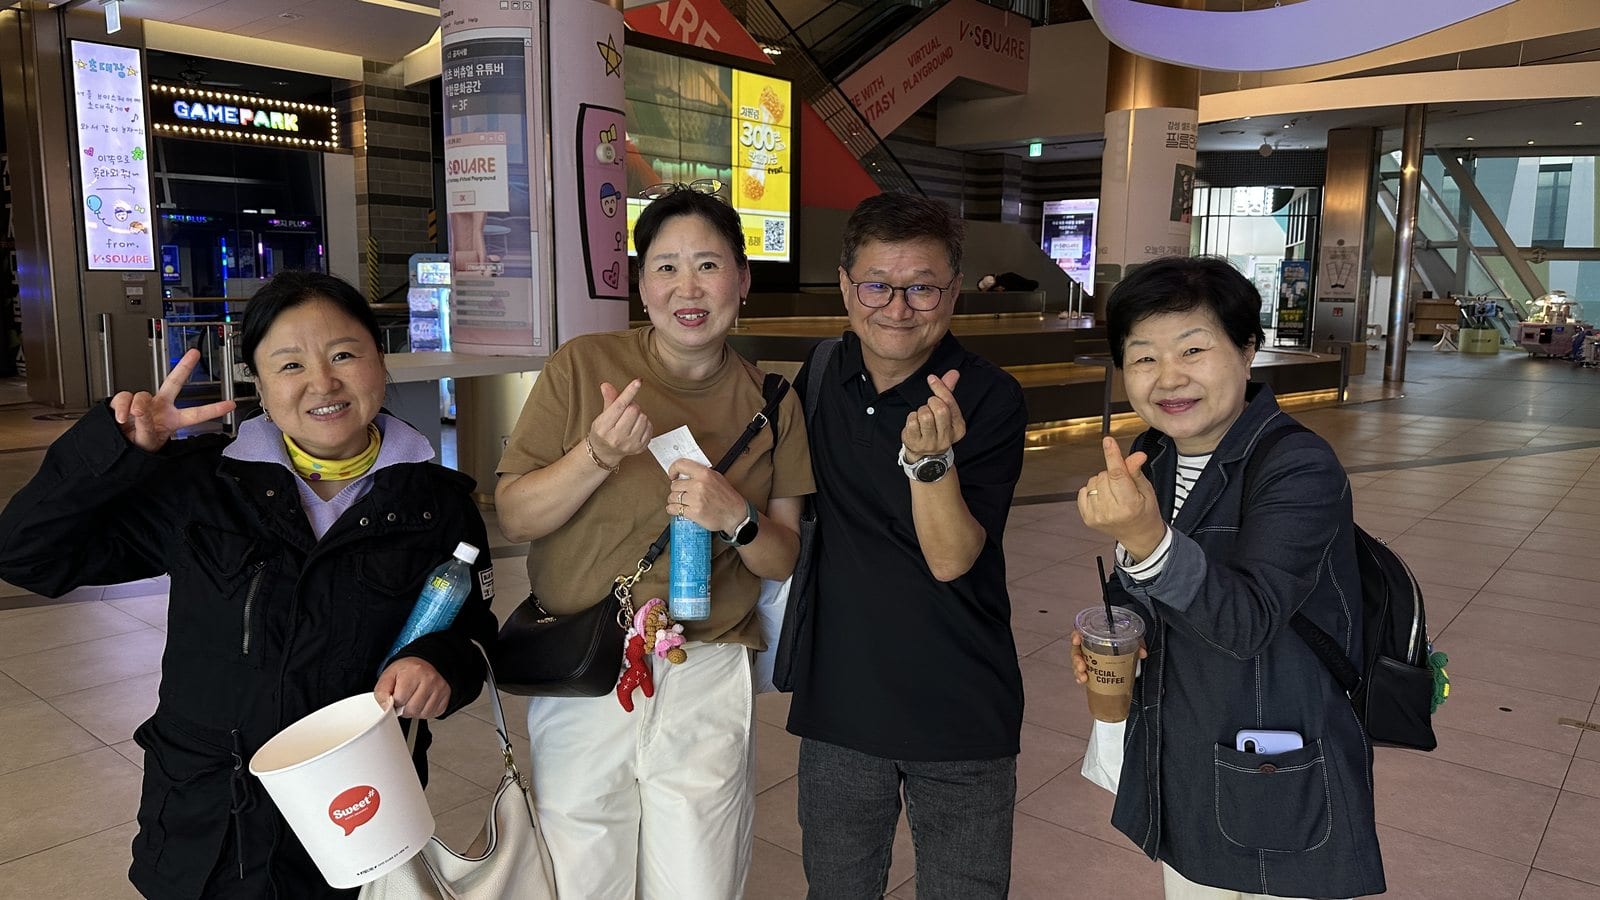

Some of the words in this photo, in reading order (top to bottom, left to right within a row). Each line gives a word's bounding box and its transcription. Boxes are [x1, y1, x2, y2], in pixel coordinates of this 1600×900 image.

[907, 36, 942, 69] VIRTUAL
[88, 58, 126, 79] 초대장
[453, 64, 474, 79] 버츄얼
[475, 62, 504, 76] 유튜버
[902, 46, 954, 94] PLAYGROUND
[860, 75, 886, 103] WITH
[458, 98, 469, 111] 3F
[173, 100, 299, 132] GAMEPARK
[97, 154, 131, 166] 이쪽으로
[1096, 675, 1126, 685] COFFEE
